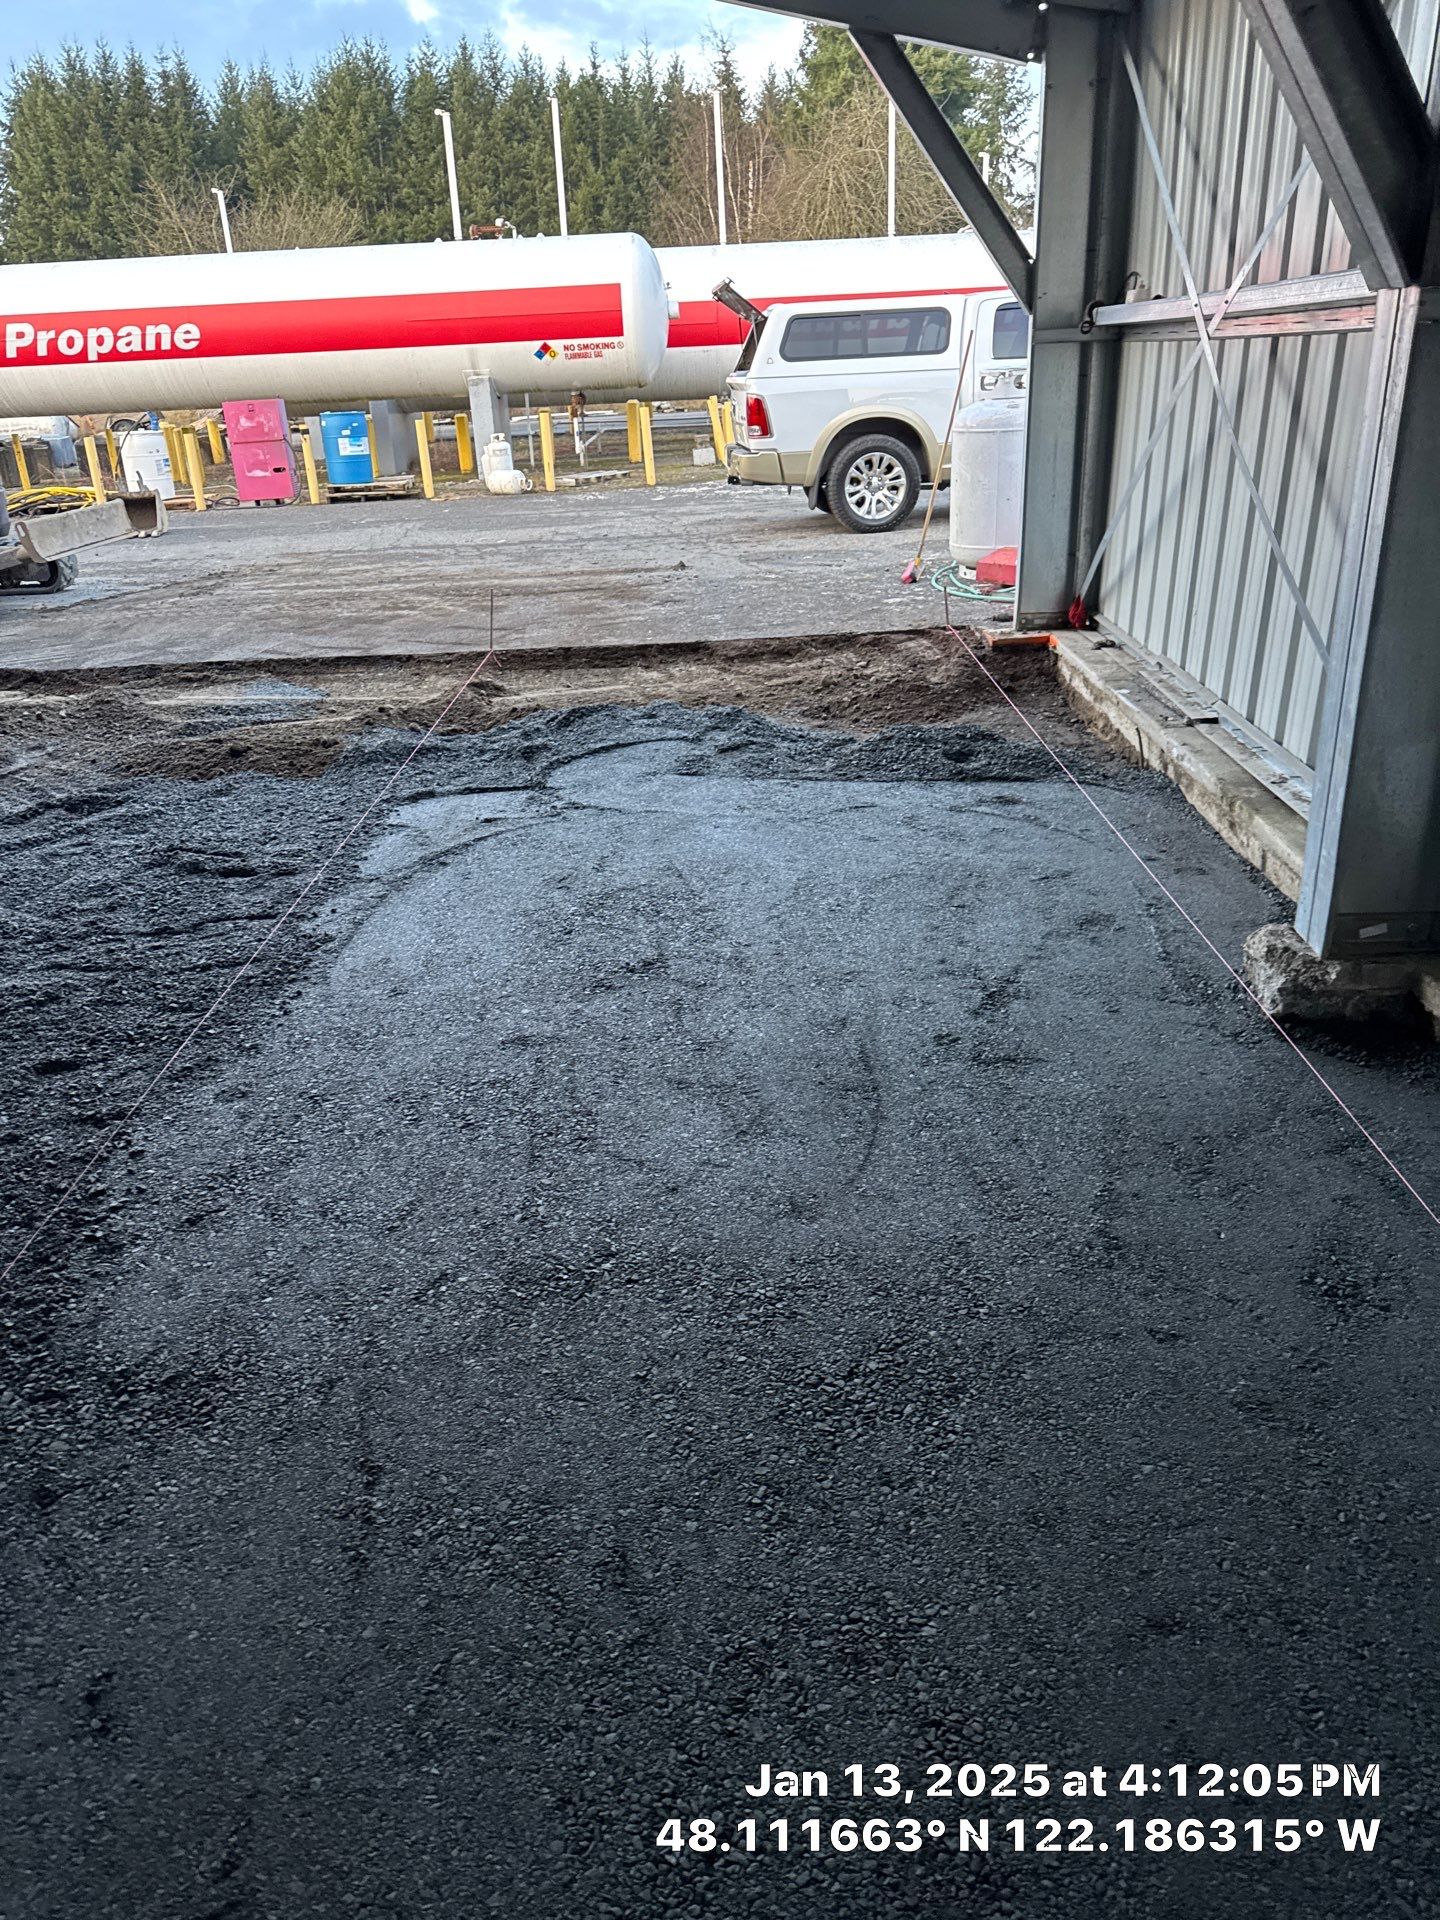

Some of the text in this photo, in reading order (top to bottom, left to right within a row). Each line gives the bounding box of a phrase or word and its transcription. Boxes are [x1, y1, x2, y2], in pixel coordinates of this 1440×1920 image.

[5, 322, 202, 361] Propane
[577, 342, 615, 351] SMOKING
[564, 351, 592, 360] FLAMMABLE
